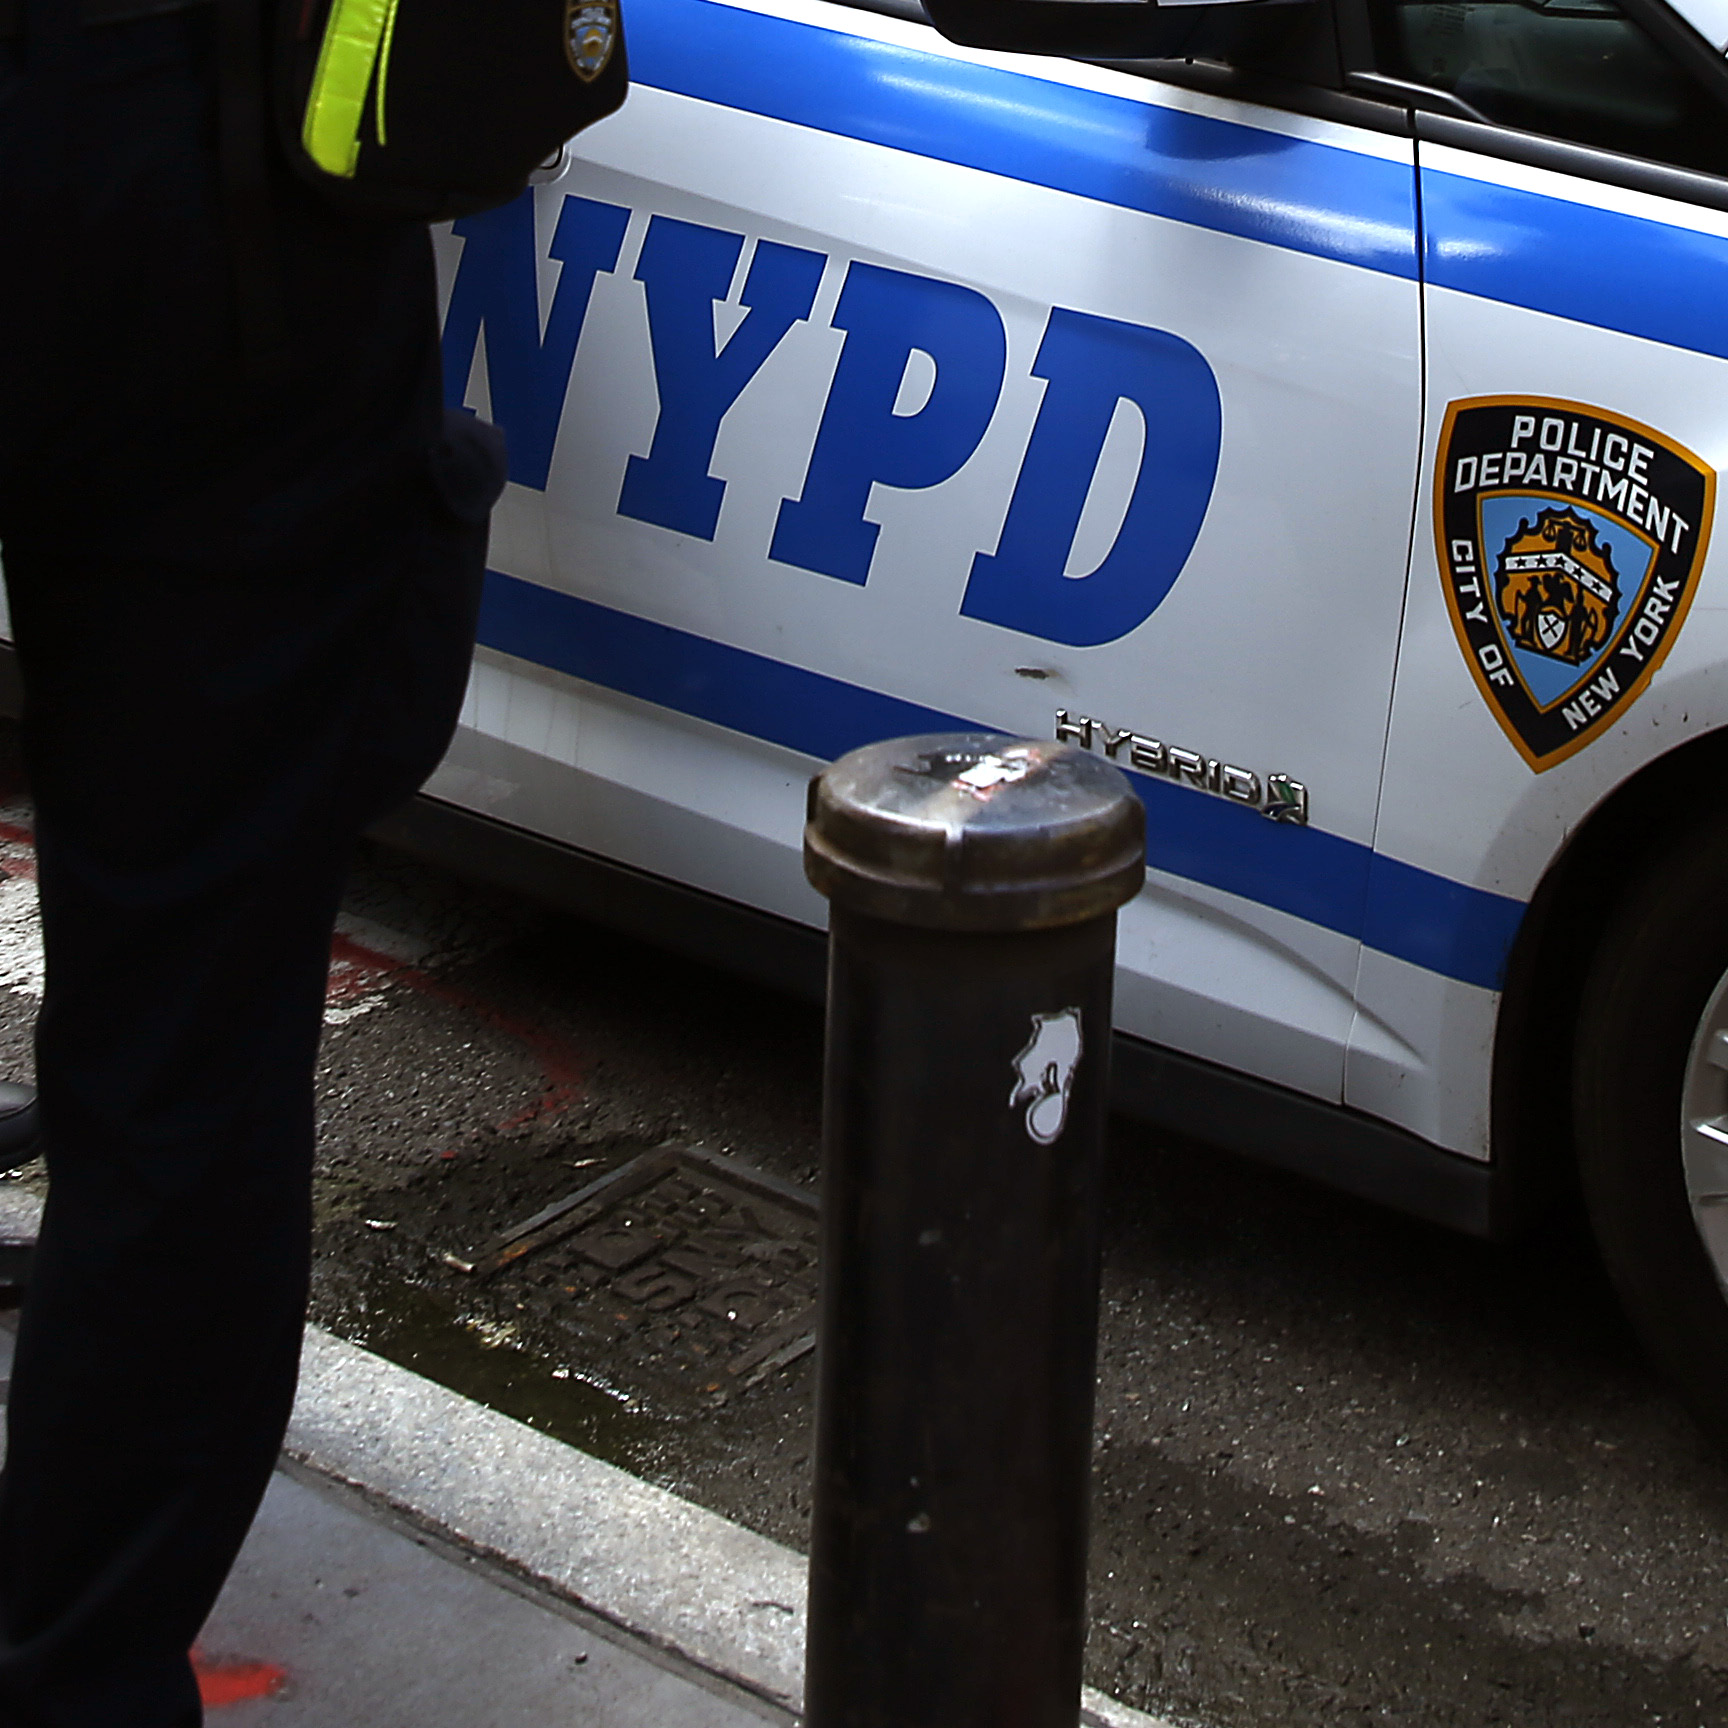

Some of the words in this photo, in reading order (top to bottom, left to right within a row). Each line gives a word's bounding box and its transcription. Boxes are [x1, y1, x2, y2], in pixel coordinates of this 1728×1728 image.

[442, 186, 1223, 650] NYPD
[1510, 414, 1655, 486] POLICE
[1453, 451, 1690, 555] DEPARTMENT
[1451, 538, 1489, 625] CITY
[1478, 643, 1515, 688] OF
[1560, 666, 1621, 731] NEW
[1620, 574, 1681, 664] YORK
[1055, 708, 1262, 806] HYBRID
